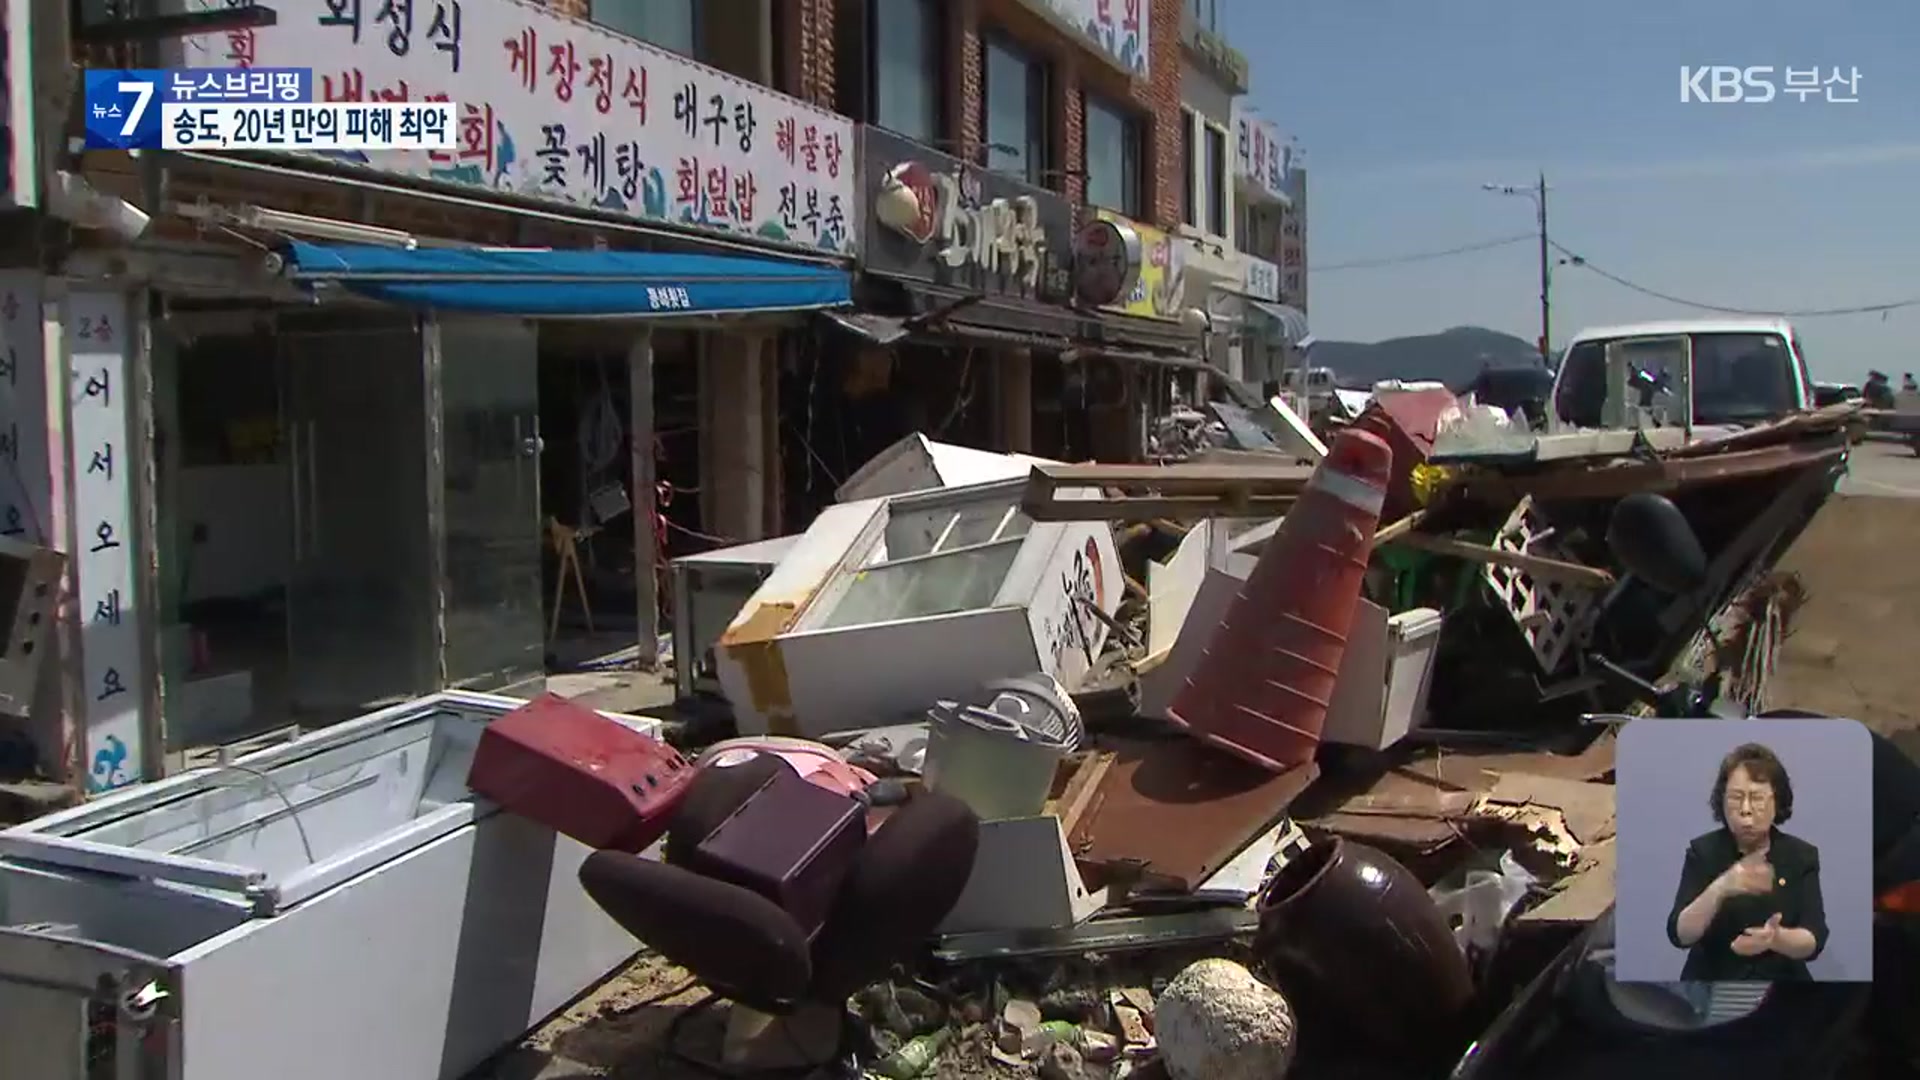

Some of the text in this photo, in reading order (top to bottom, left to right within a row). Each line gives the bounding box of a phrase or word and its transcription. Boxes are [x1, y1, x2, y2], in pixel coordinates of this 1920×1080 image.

[503, 26, 647, 127] 게장정식
[673, 81, 757, 153] 대구탕
[775, 117, 843, 179] 해물탕
[535, 123, 646, 200] 꽃게탕
[675, 155, 758, 222] 회덮밥
[777, 181, 847, 242] 전복죽
[85, 367, 127, 702] 어서오세요
